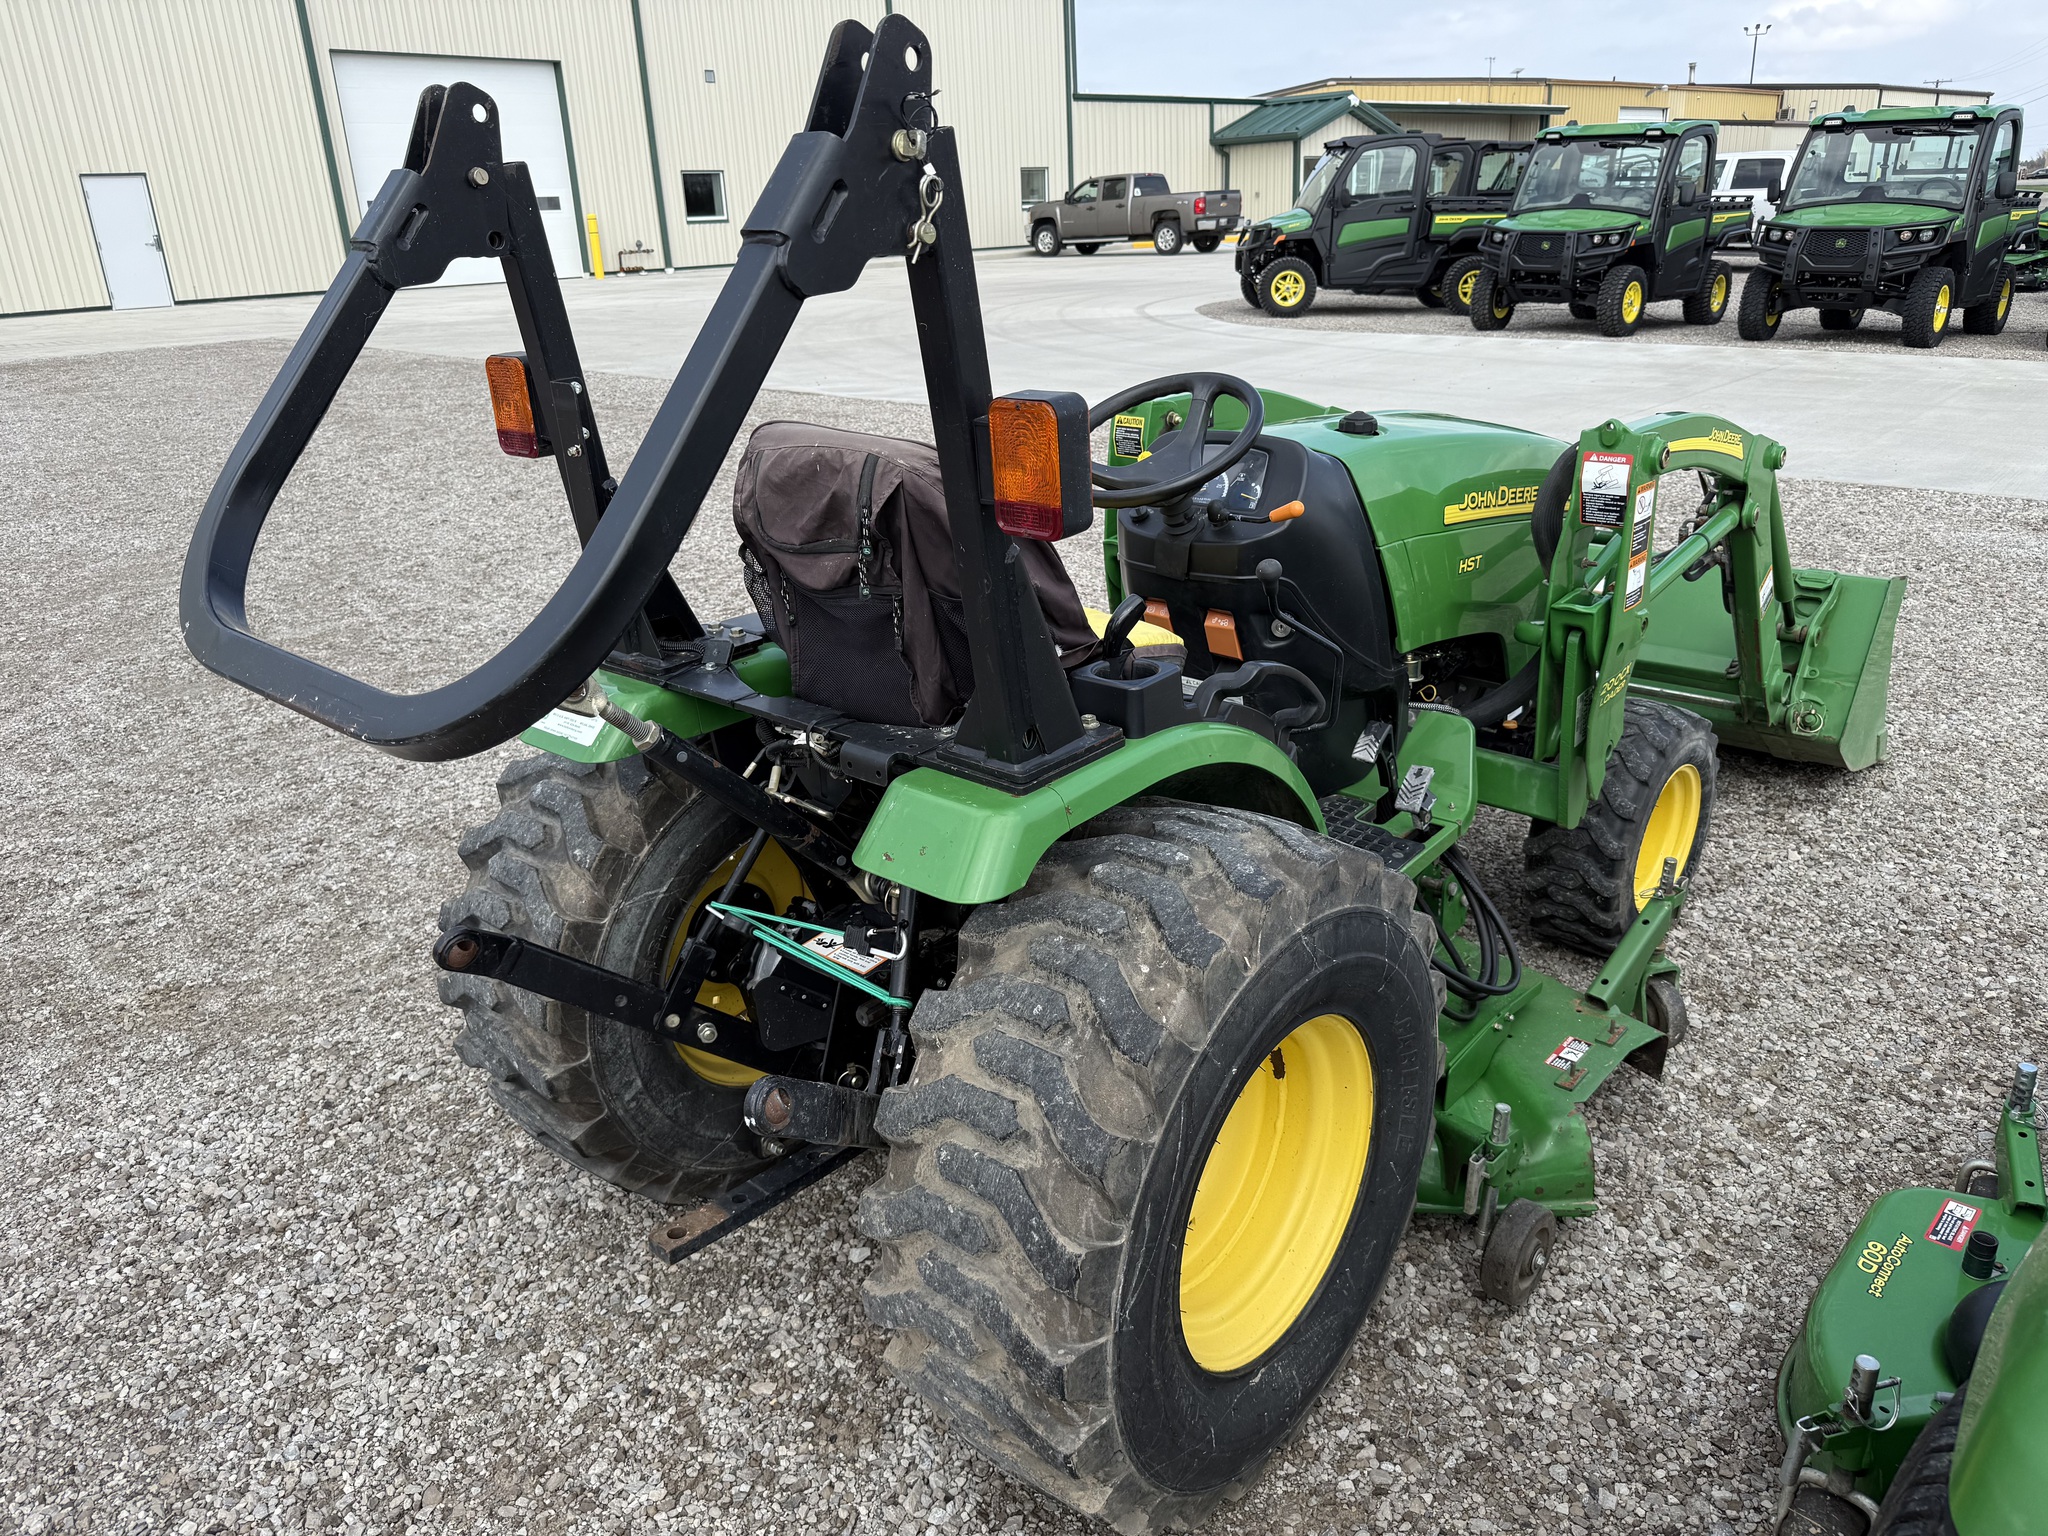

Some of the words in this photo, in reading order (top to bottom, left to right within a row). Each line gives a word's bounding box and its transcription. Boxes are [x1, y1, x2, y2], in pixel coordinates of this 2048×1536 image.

[1123, 417, 1143, 426] CAUTION
[1709, 427, 1725, 442] JOHN
[1724, 429, 1742, 444] DEERE
[1599, 455, 1627, 463] DANGER
[1459, 490, 1496, 511] JOHN
[1497, 485, 1539, 507] DEERE
[1458, 554, 1483, 574] HST
[1600, 662, 1632, 696] 200CX
[1599, 679, 1626, 707] LOADER
[1393, 1016, 1420, 1154] CARLISLE
[1857, 1241, 1888, 1274] 60D
[1868, 1232, 1914, 1298] AutoConnect
